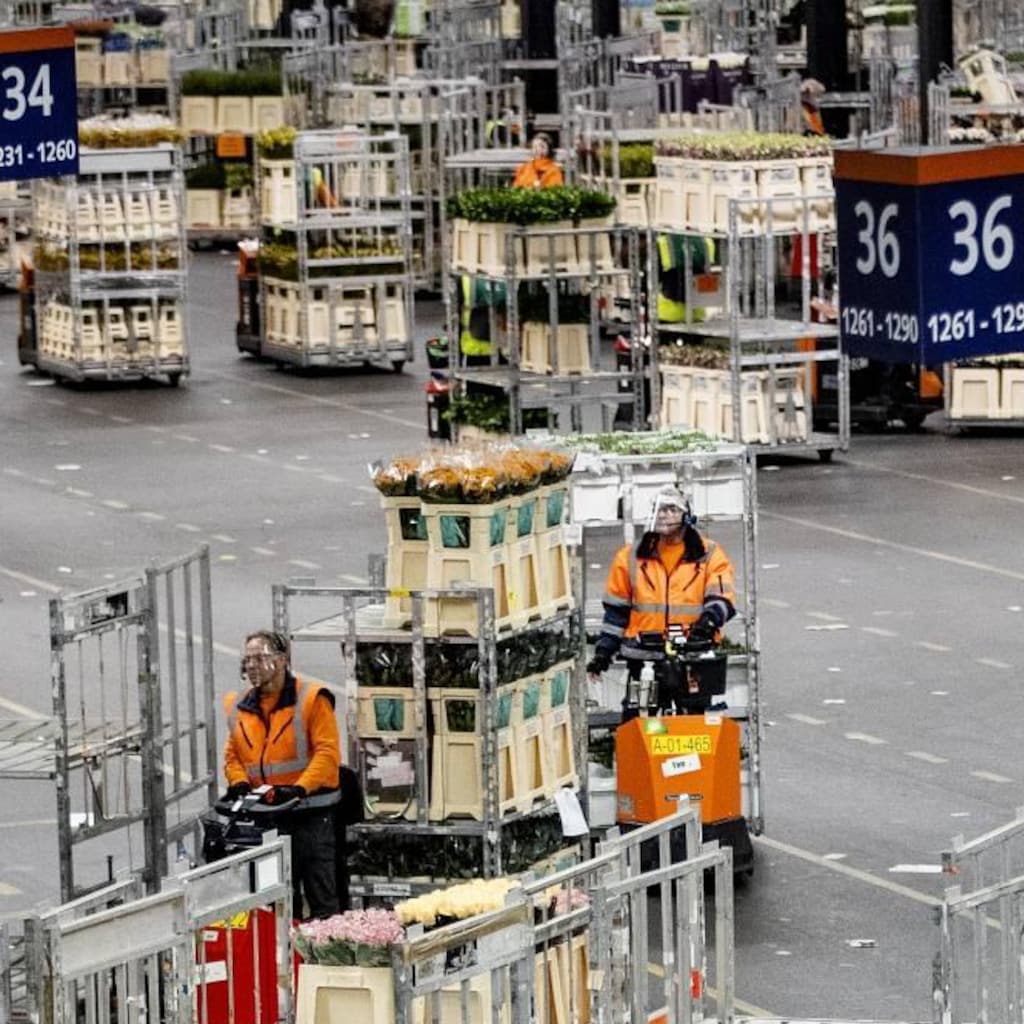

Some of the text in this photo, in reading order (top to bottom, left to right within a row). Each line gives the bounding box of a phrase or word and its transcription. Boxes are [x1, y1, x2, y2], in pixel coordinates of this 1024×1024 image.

[2, 64, 54, 121] 34
[37, 139, 76, 163] 1260
[854, 200, 900, 278] 36
[948, 195, 1014, 276] 36
[842, 307, 874, 337] 1261
[885, 312, 919, 344] 1290
[928, 309, 975, 343] 1261
[653, 736, 711, 753] A-01-465
